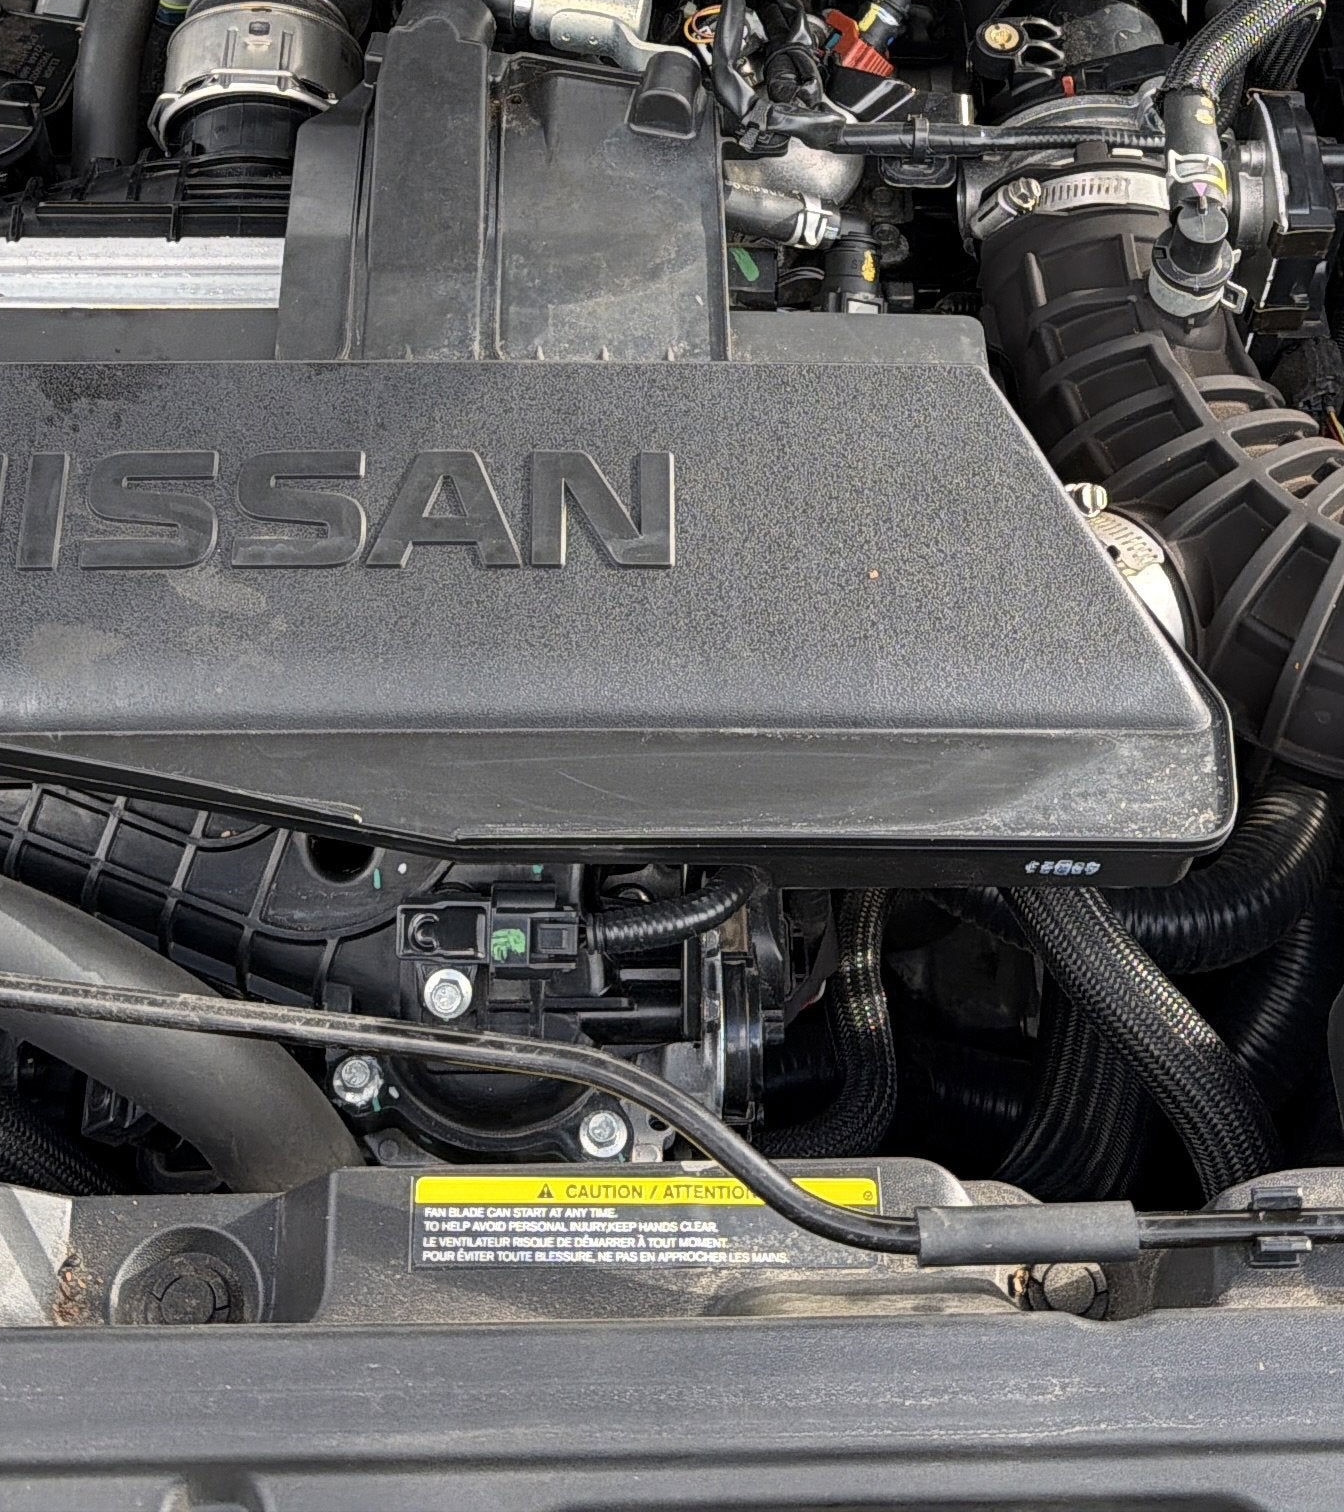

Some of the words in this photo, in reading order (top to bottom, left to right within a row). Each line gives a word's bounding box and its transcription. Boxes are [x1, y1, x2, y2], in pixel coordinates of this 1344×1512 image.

[566, 1184, 643, 1199] CAUTION
[649, 1185, 658, 1199] /
[424, 1207, 447, 1218] FAN
[449, 1207, 485, 1218] BLADE
[487, 1207, 511, 1218] CAN
[513, 1207, 547, 1218] START
[549, 1207, 564, 1218] AT
[565, 1207, 590, 1218] ANY
[591, 1207, 618, 1218] TIME.
[424, 1221, 439, 1232] TO
[441, 1221, 471, 1232] HELP
[472, 1221, 506, 1232] AVOID
[508, 1221, 568, 1232] PERSONAL
[638, 1221, 678, 1232] HANDS
[680, 1221, 719, 1232] CLEAR.
[423, 1237, 438, 1248] LE
[439, 1237, 510, 1248] VENTILATEUR
[513, 1237, 555, 1248] RISQUE
[557, 1237, 573, 1248] DE
[574, 1235, 635, 1248] DÉMARRER
[637, 1235, 646, 1248] À
[647, 1237, 676, 1248] TOUT
[679, 1237, 729, 1248] MOMENT.
[422, 1251, 455, 1263] POUR
[457, 1249, 494, 1263] ÉVITER
[496, 1251, 533, 1263] TOUTE
[535, 1251, 595, 1263] BLESSURE,
[598, 1252, 613, 1263] NE
[615, 1252, 638, 1263] PAS
[640, 1252, 655, 1263] EN
[657, 1252, 727, 1263] APPROCHER
[728, 1252, 750, 1263] LES
[751, 1252, 790, 1263] MAINS.
